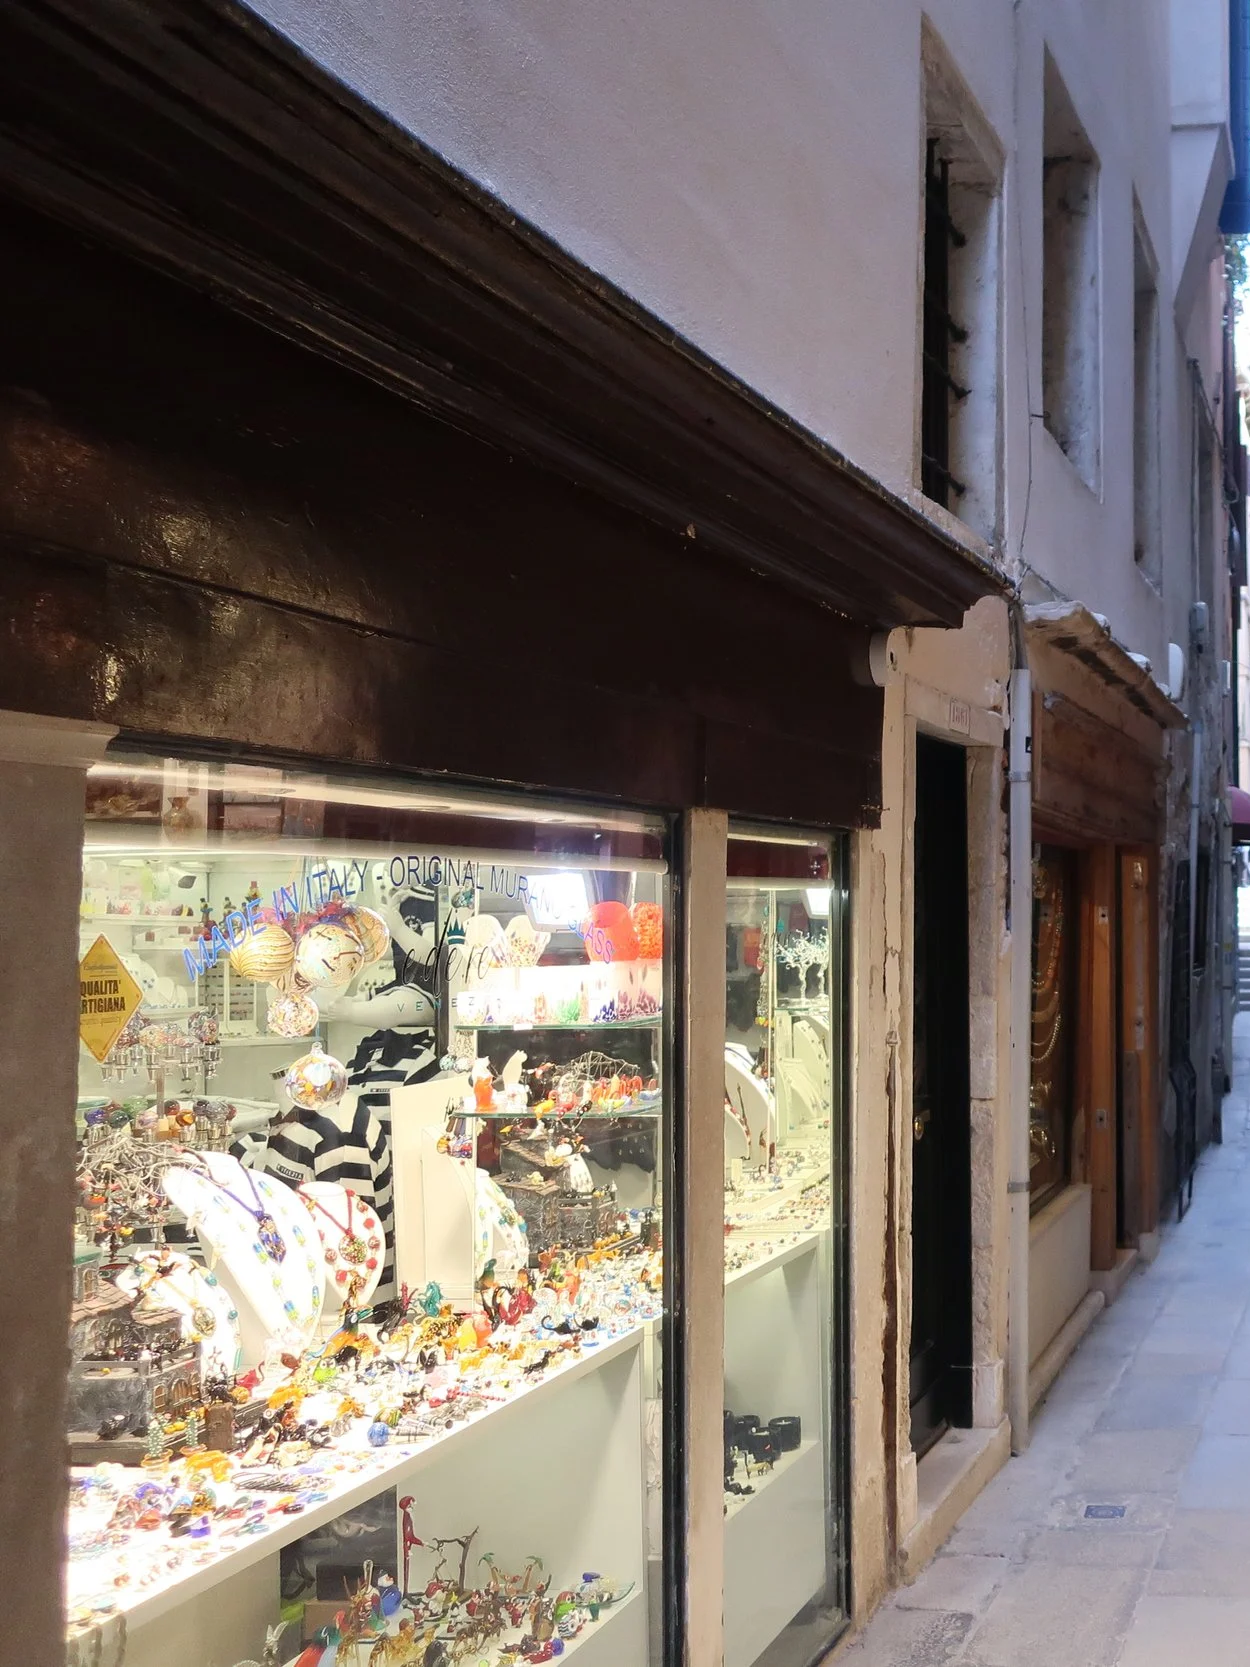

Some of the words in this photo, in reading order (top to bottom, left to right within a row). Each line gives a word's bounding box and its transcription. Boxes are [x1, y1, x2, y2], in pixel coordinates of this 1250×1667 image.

[182, 897, 269, 982] MADE
[272, 882, 300, 922] IN
[305, 860, 369, 908] ITALY
[389, 856, 485, 891] ORIGINAL
[567, 919, 614, 965] GLASS
[80, 980, 121, 998] QUALITA'
[80, 997, 126, 1014] RTIGIANA
